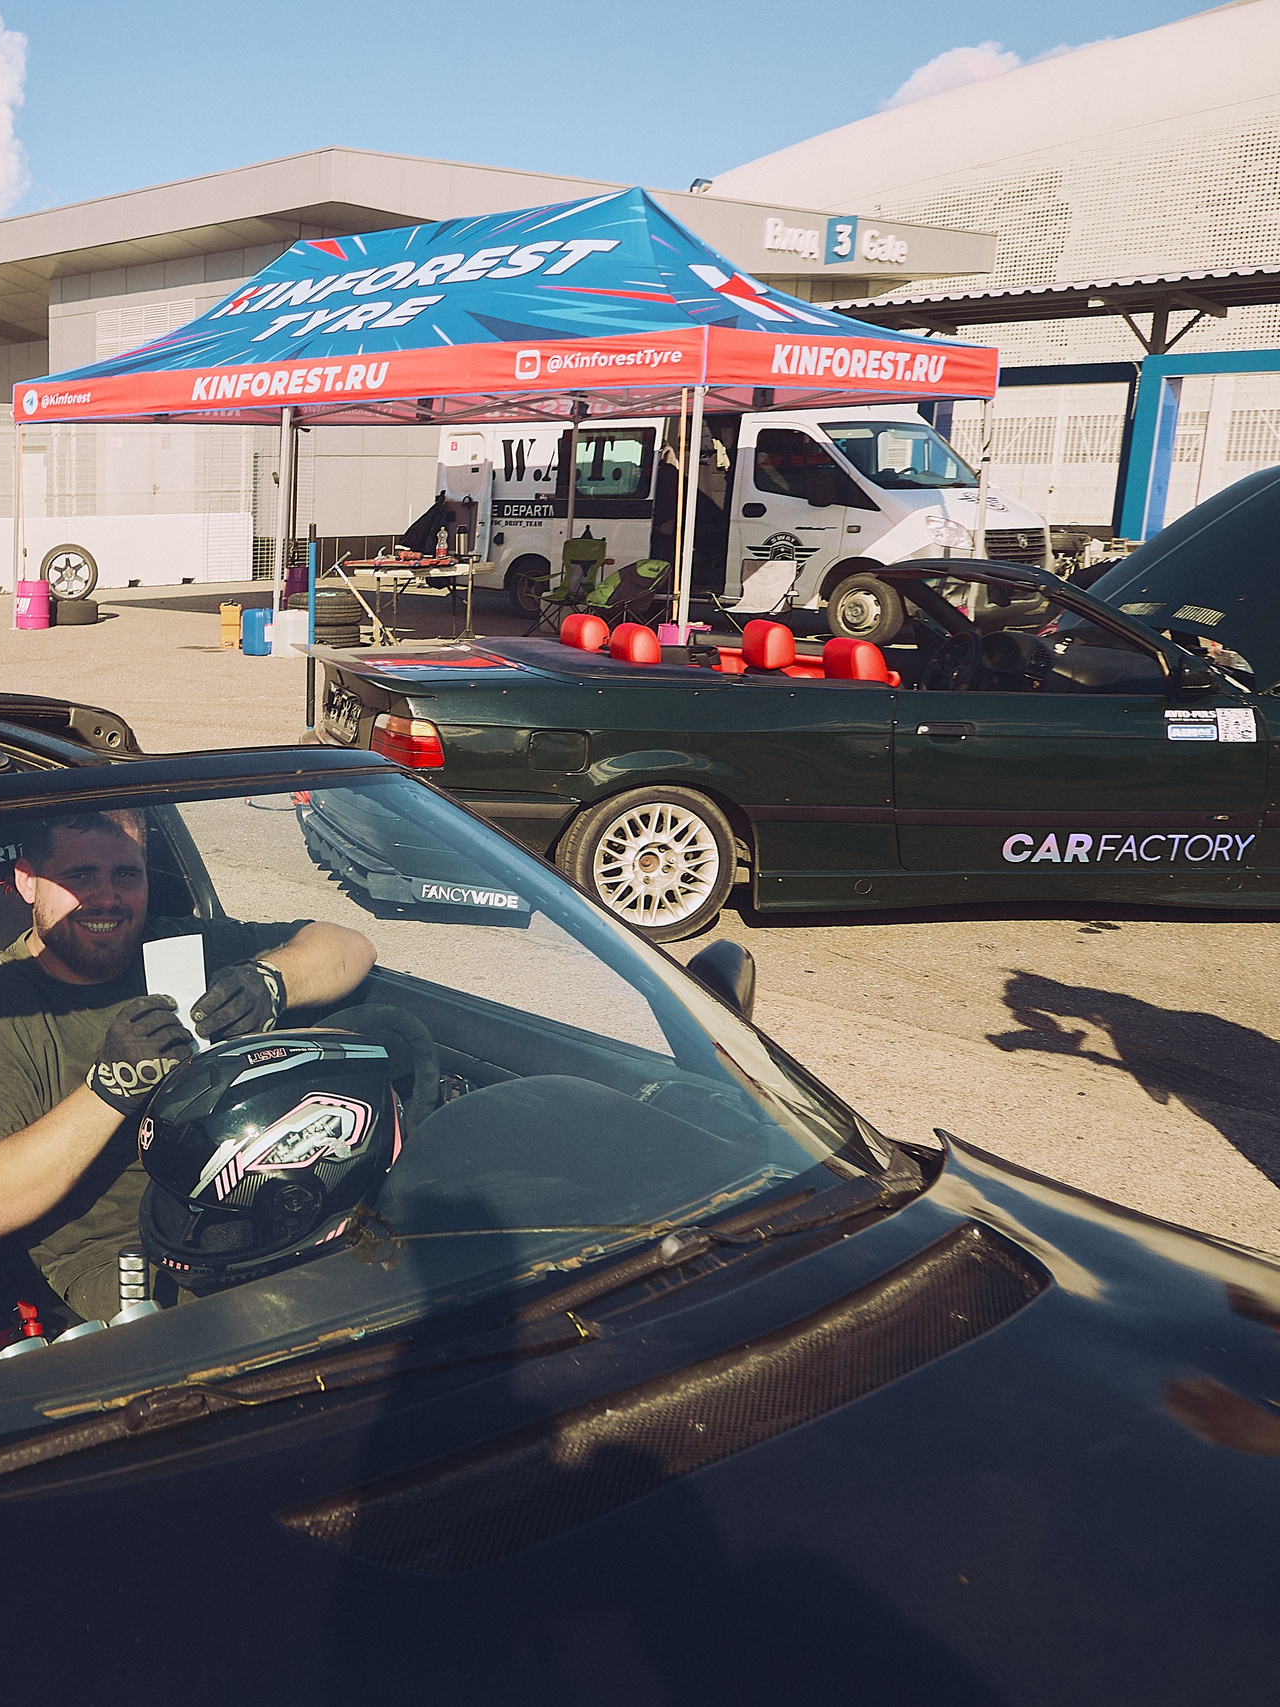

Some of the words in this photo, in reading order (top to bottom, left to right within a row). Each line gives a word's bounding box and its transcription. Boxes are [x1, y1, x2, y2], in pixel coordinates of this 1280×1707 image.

[765, 217, 820, 259] Вход
[833, 224, 853, 256] 3
[862, 229, 908, 263] Gate
[208, 239, 621, 321] KINFOREST
[250, 294, 446, 343] TYRE
[546, 348, 683, 373] @KinforestTyre
[771, 344, 947, 384] KINFOREST.RU
[41, 391, 92, 409] @Kinforest
[191, 362, 389, 402] KINFOREST.RU
[771, 535, 796, 544] SWAT
[98, 1058, 181, 1098] spar
